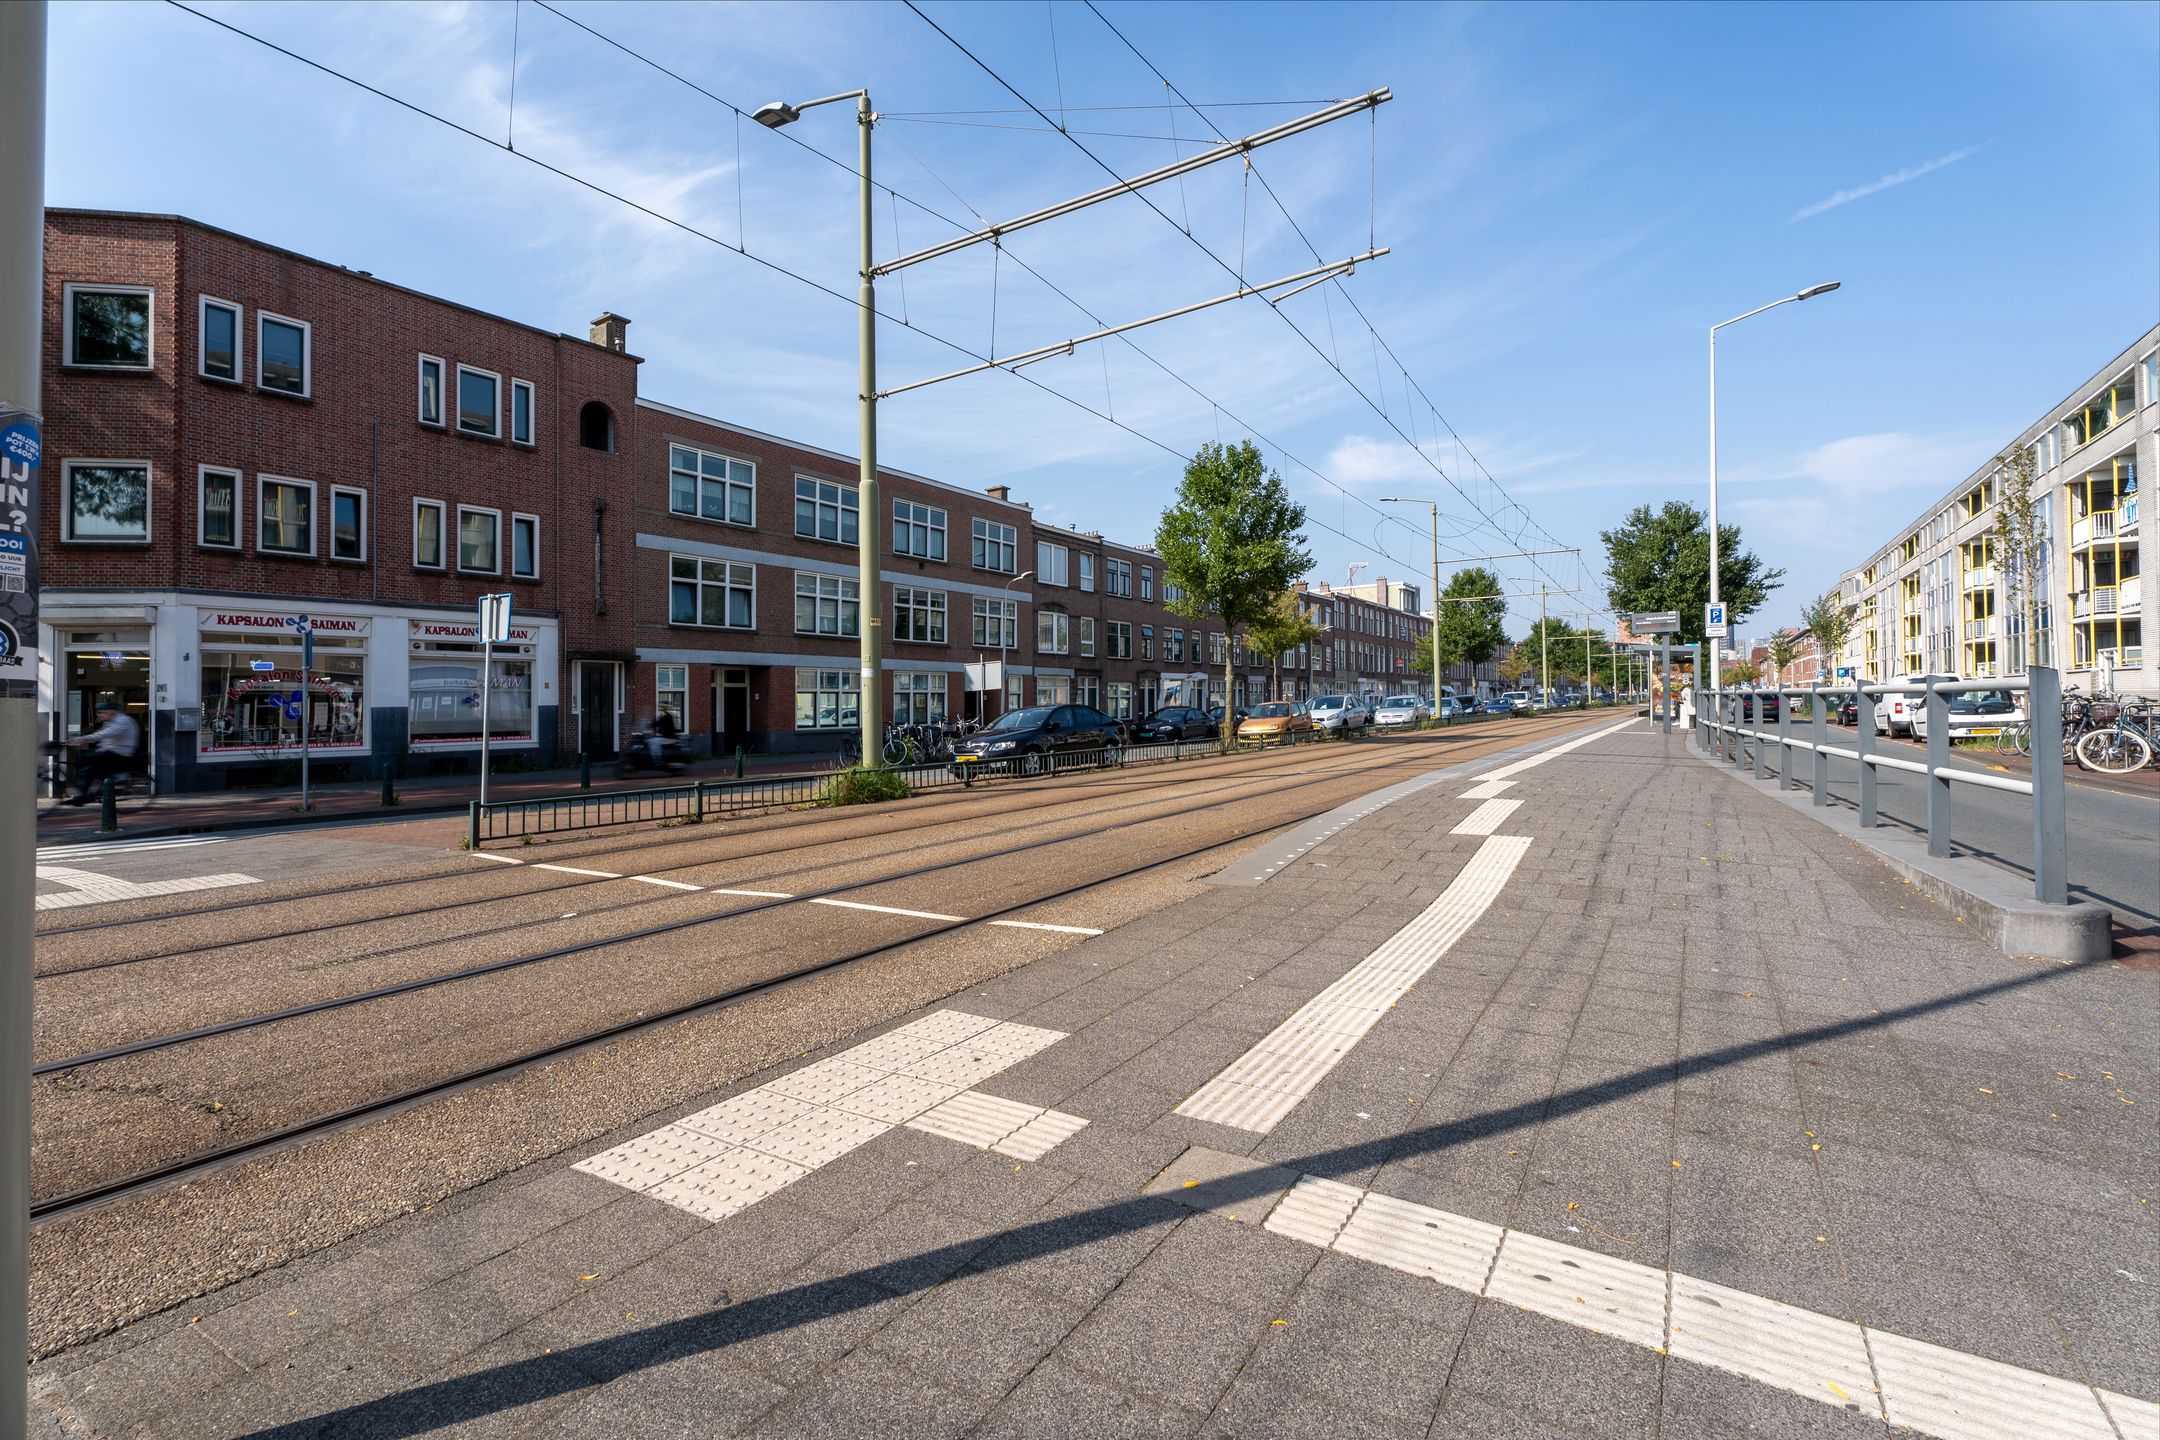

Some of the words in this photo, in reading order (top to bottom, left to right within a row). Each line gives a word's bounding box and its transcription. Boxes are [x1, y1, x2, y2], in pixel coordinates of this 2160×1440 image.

[5, 436, 24, 447] POT
[216, 614, 284, 628] KAPSALON
[310, 619, 356, 631] SAIMAN
[424, 625, 475, 637] KAPSALON
[226, 670, 290, 701] Kapsalon
